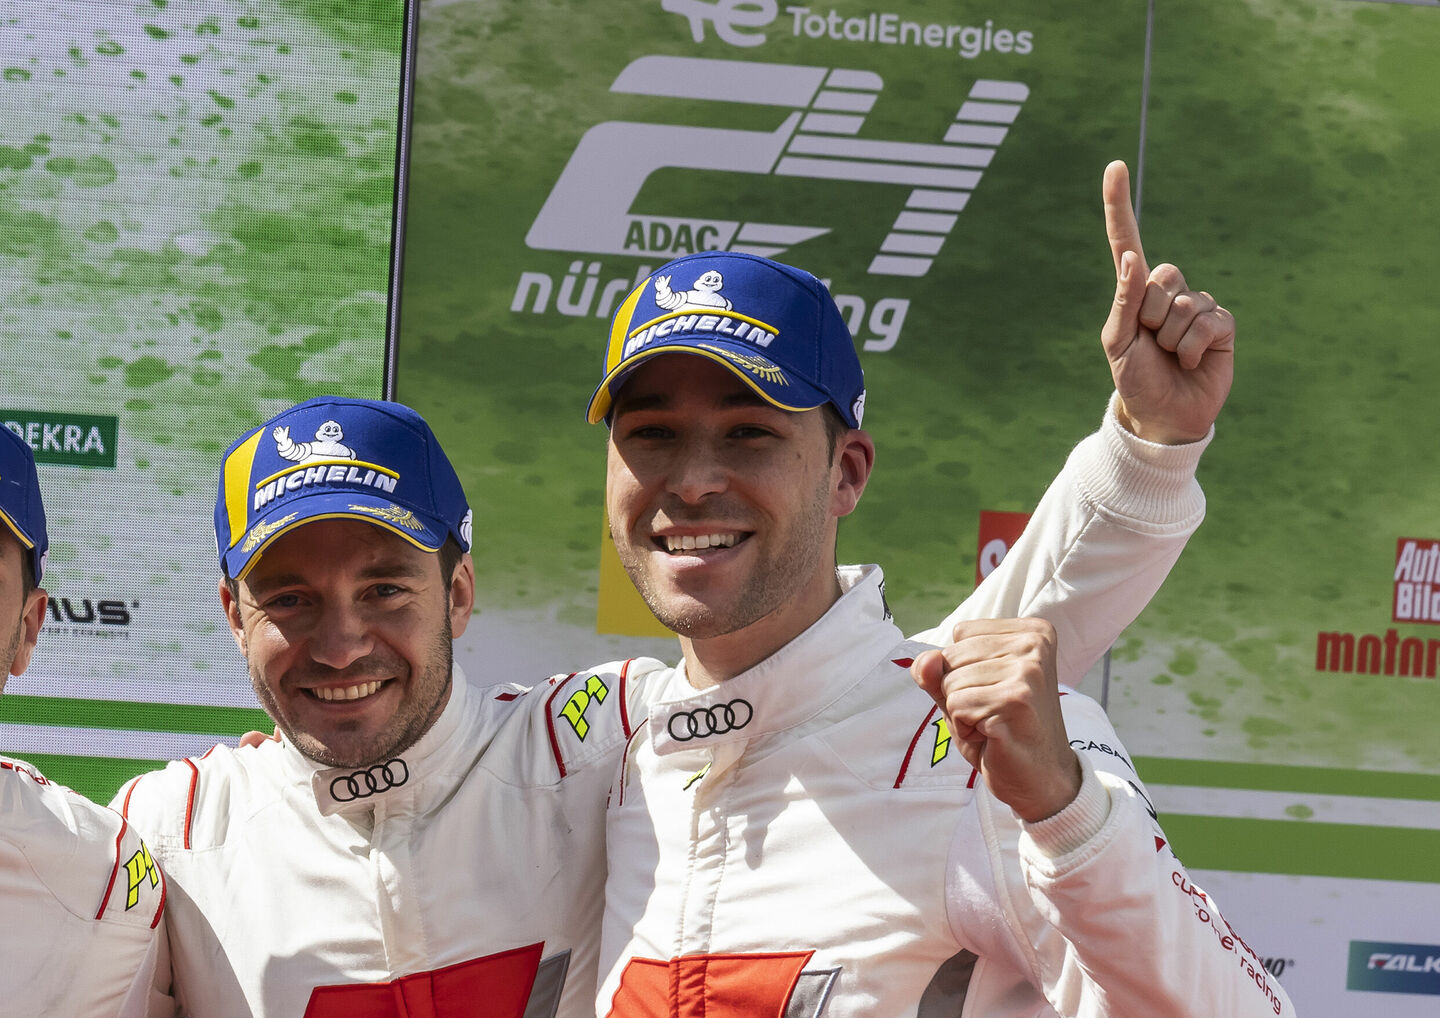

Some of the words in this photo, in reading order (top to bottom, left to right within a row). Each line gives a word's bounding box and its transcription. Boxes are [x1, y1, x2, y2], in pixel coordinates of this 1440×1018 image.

[786, 7, 1034, 58] TotalEnergies
[623, 220, 720, 254] ADAC
[624, 314, 777, 359] MICHELIN
[253, 464, 398, 512] MICHELIN
[1394, 541, 1440, 584] Aut
